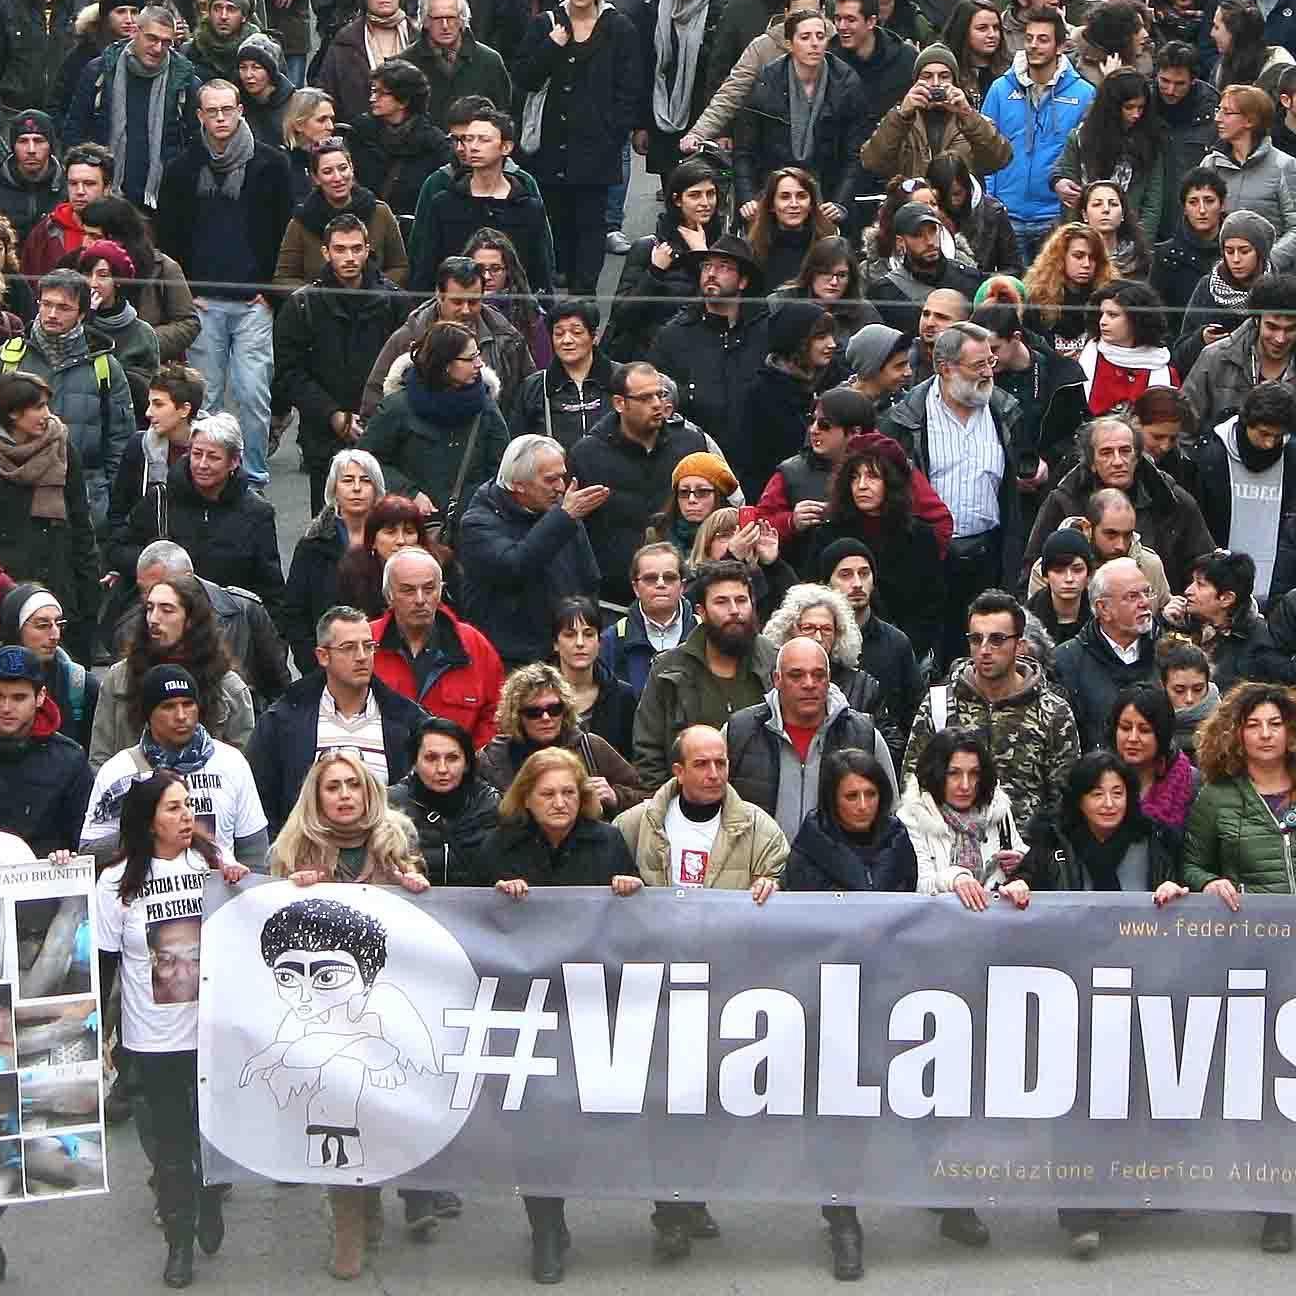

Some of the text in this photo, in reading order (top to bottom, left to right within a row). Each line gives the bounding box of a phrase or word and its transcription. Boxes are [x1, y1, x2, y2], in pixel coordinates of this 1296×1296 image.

[31, 866, 92, 882] BRUNETTI
[175, 875, 181, 892] E
[145, 903, 164, 921] PER
[933, 1159, 1095, 1179] Associazione
[1109, 1160, 1214, 1180] Federico
